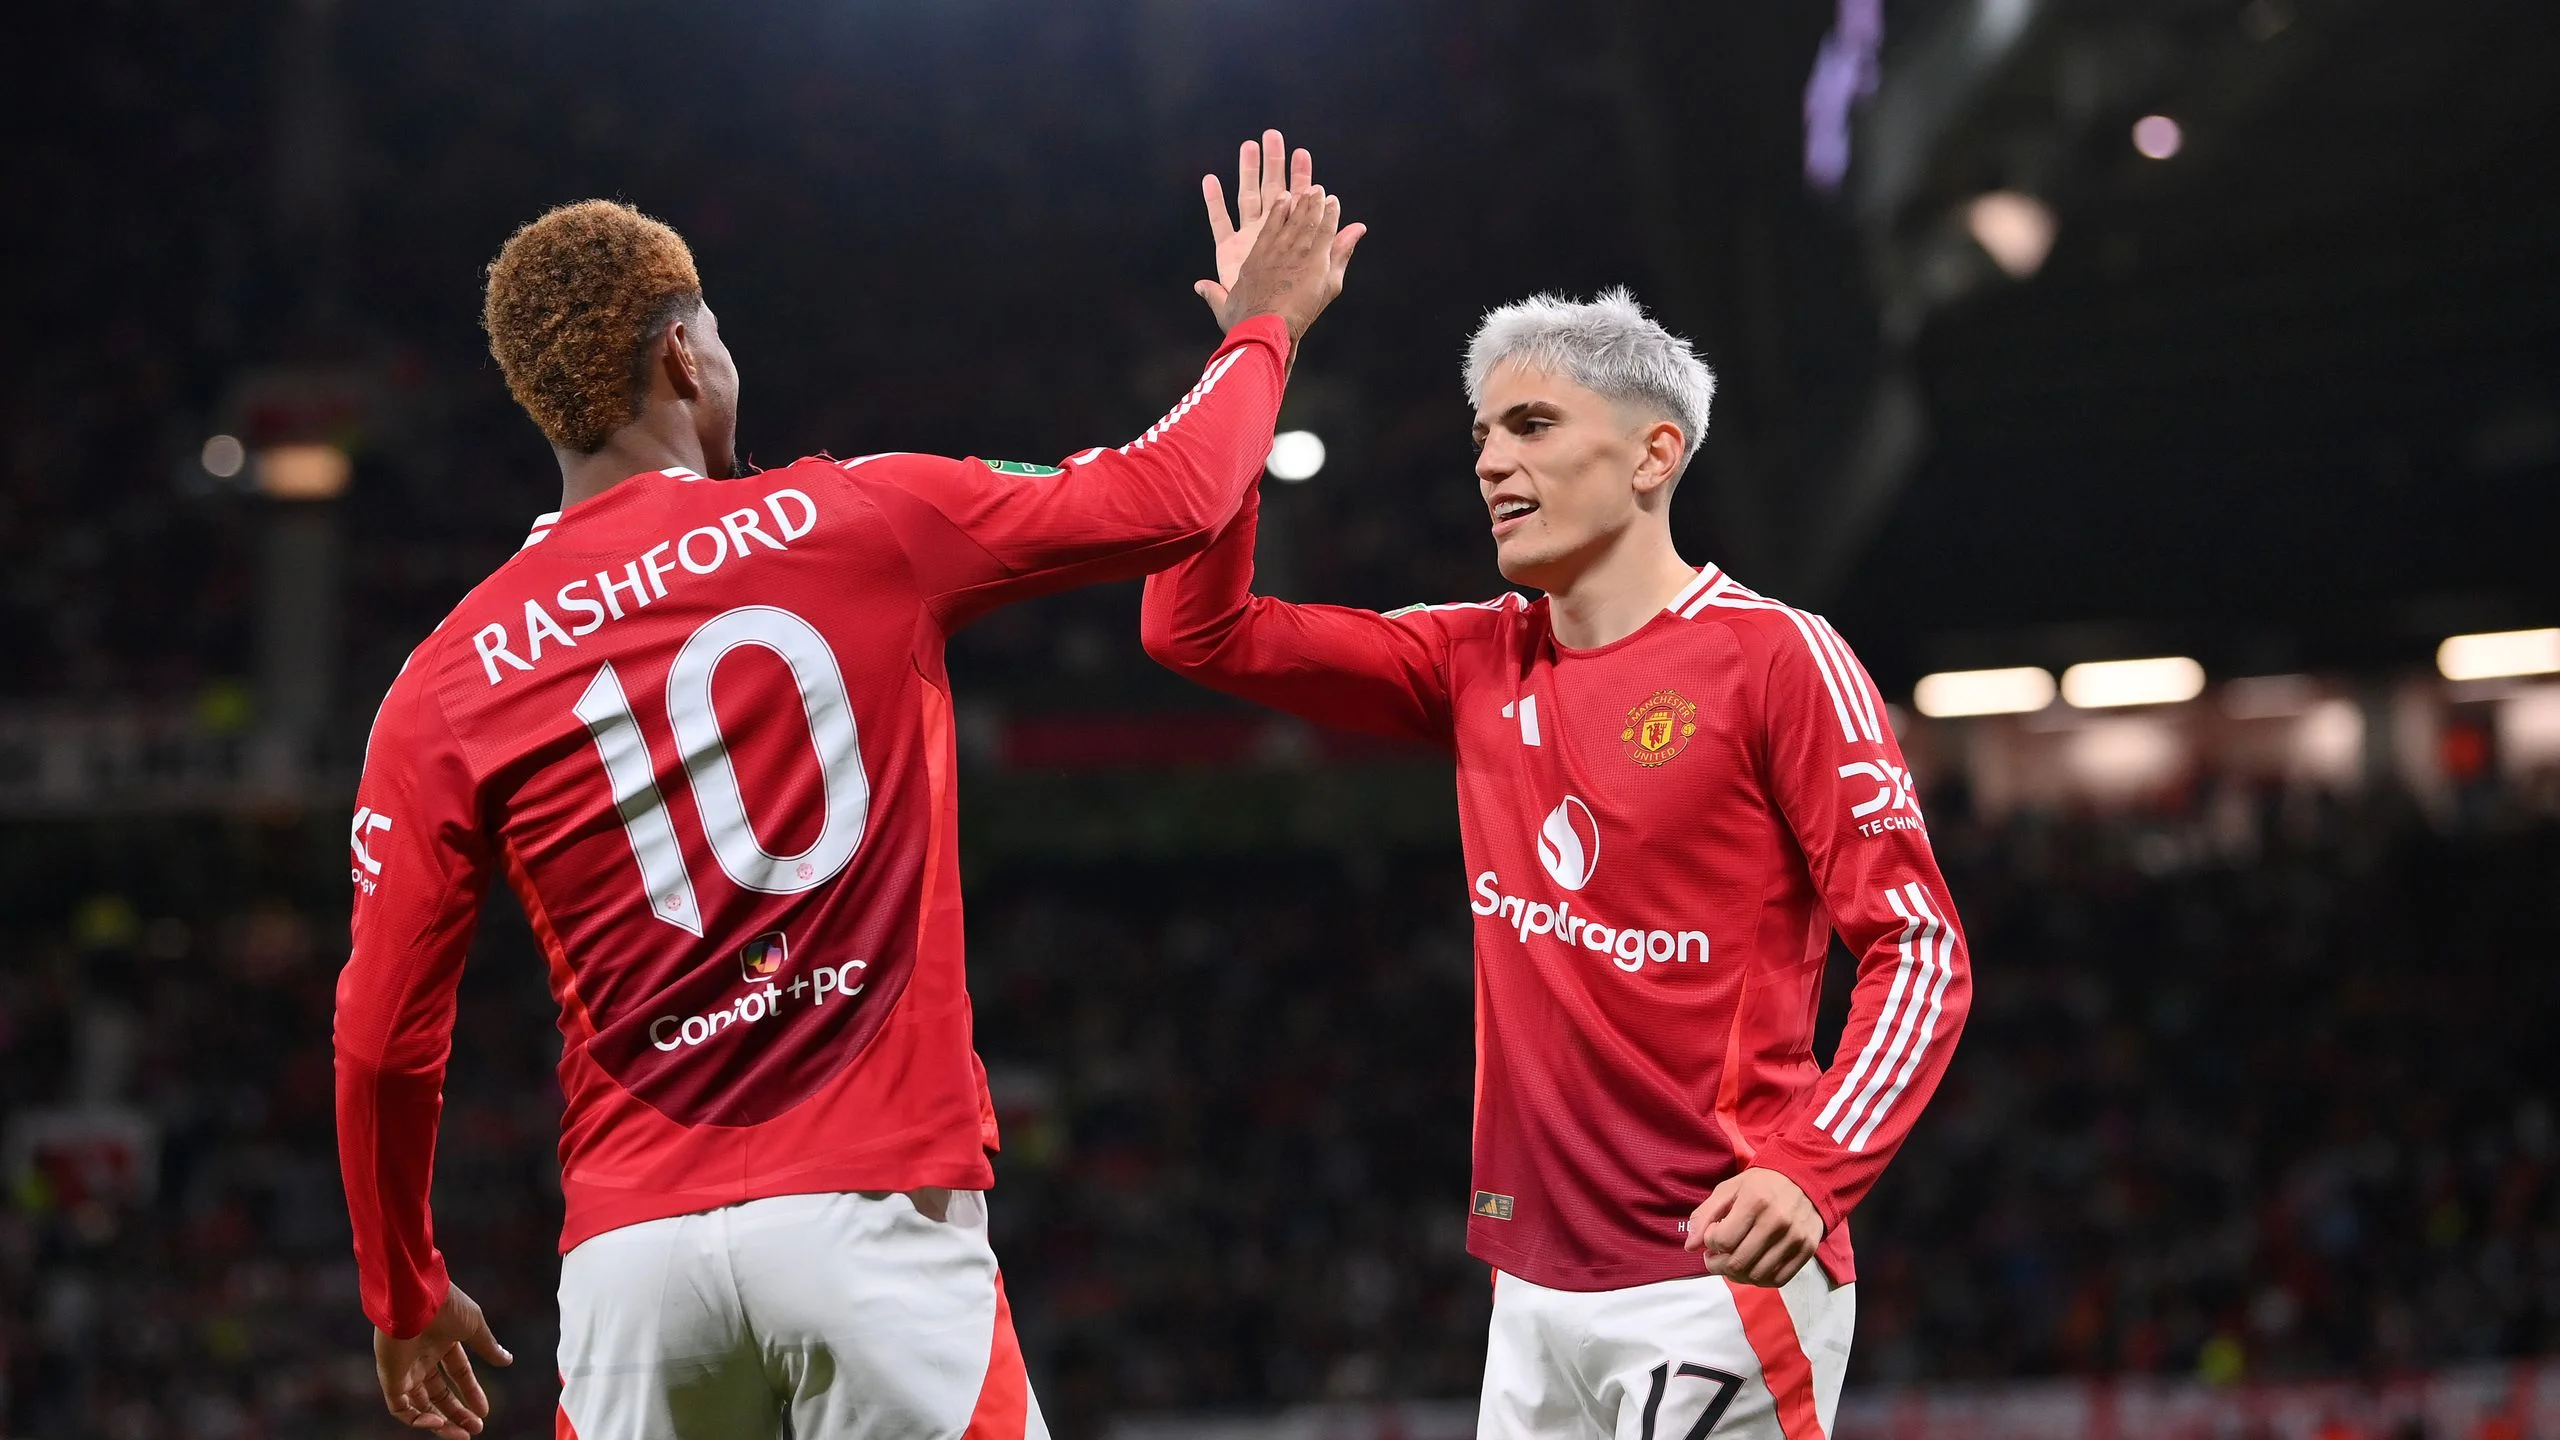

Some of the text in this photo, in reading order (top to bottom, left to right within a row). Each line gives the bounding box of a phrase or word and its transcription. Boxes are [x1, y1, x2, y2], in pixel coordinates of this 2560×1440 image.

[472, 488, 818, 686] RASHFORD
[1631, 695, 1690, 722] MANCHESTER
[571, 604, 870, 939] 10
[1633, 747, 1676, 762] UNITED
[1641, 1360, 1749, 1440] 17
